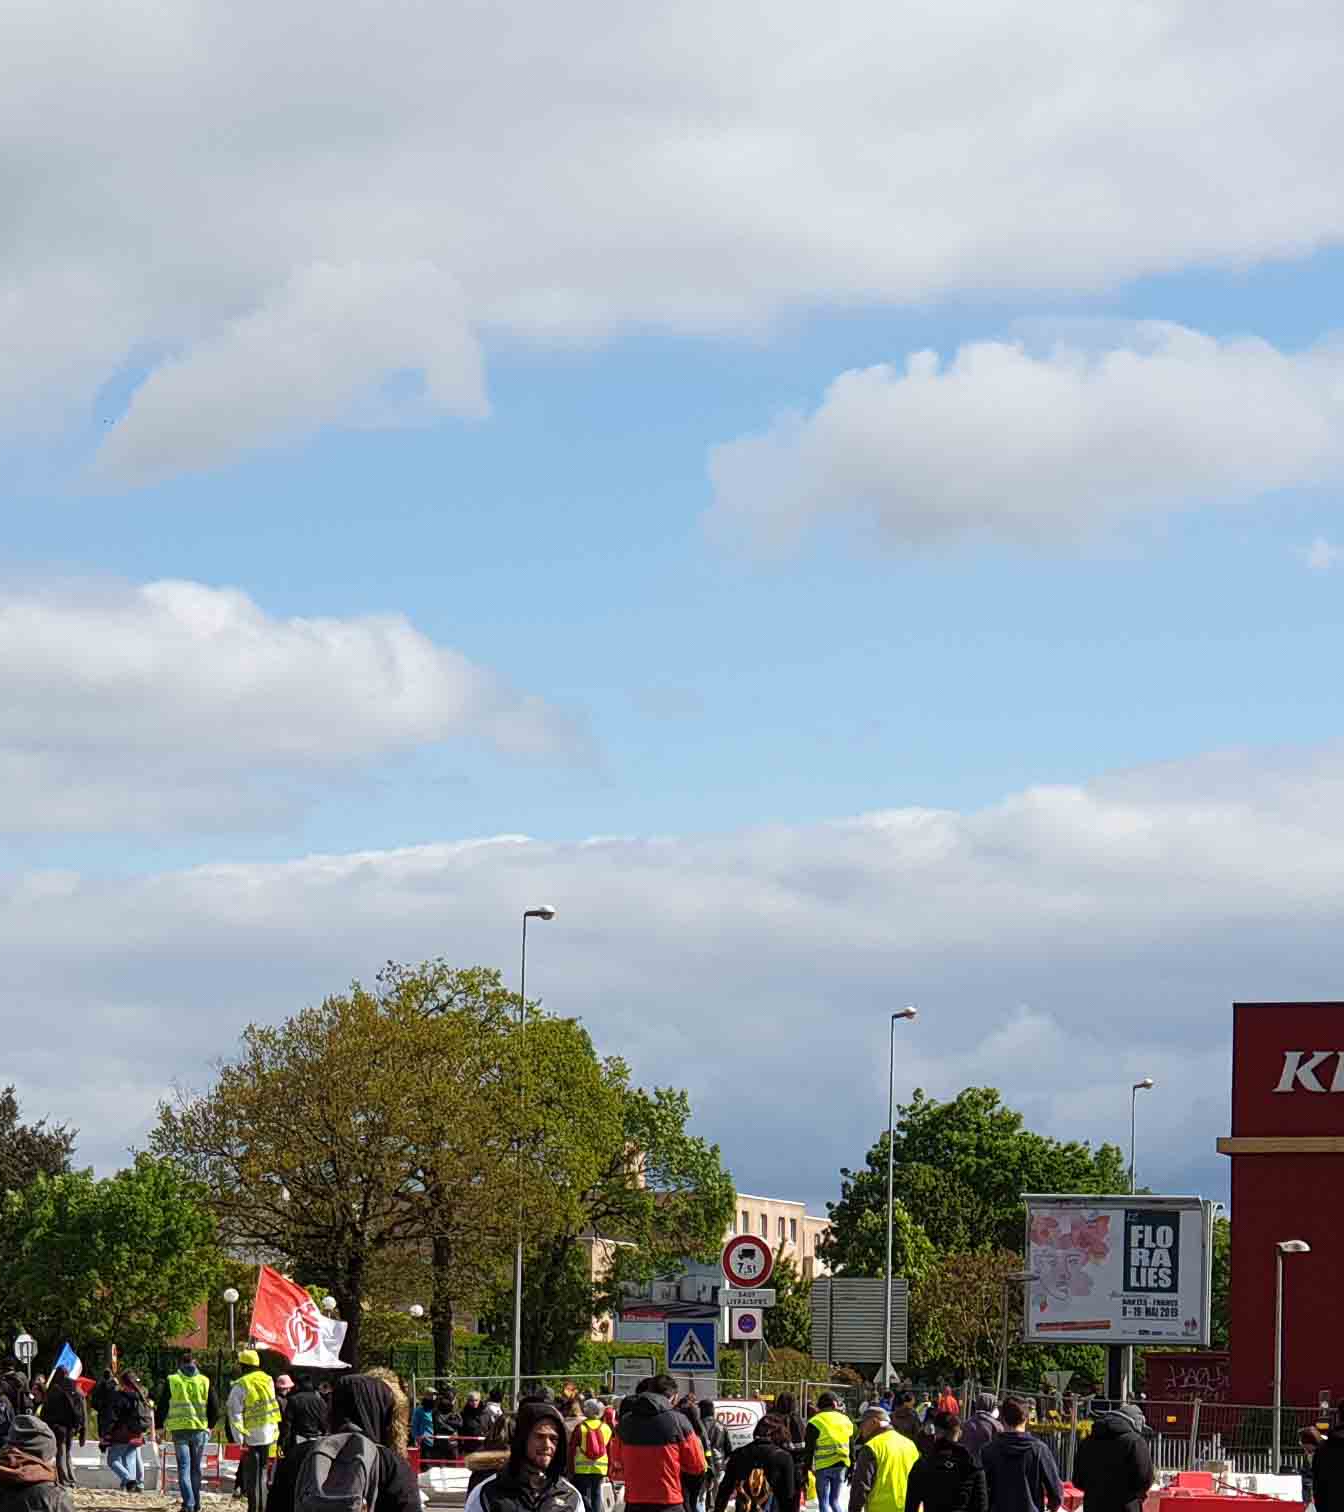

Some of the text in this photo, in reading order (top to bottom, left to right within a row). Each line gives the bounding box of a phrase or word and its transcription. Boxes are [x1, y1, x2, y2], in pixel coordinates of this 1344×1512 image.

[1130, 1225, 1174, 1248] FLO
[1130, 1249, 1173, 1267] RA
[1130, 1267, 1172, 1288] LIES
[716, 1411, 752, 1425] ODIN
